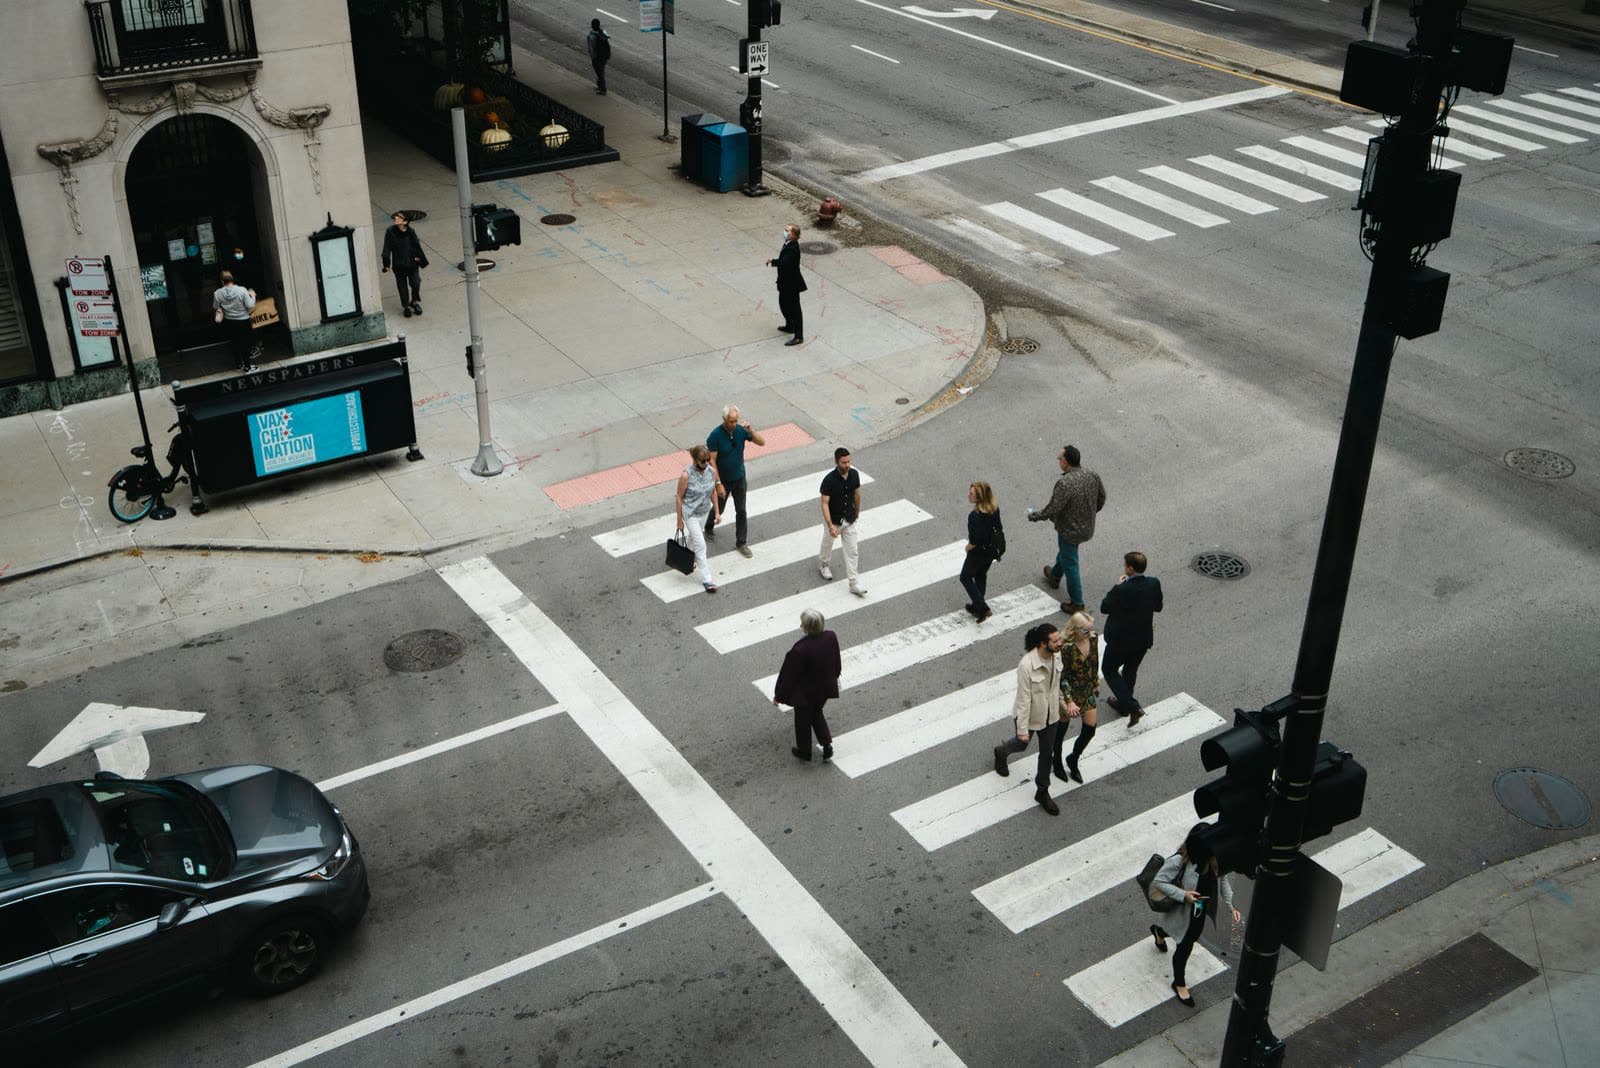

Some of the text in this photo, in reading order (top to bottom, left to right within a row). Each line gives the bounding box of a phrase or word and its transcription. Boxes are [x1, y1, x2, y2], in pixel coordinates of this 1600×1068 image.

[750, 44, 767, 54] ONE
[750, 54, 767, 63] WAY
[253, 313, 268, 323] NIKE
[222, 355, 355, 393] NEWSPAPERS
[259, 411, 285, 430] VAX
[263, 436, 313, 460] NATION
